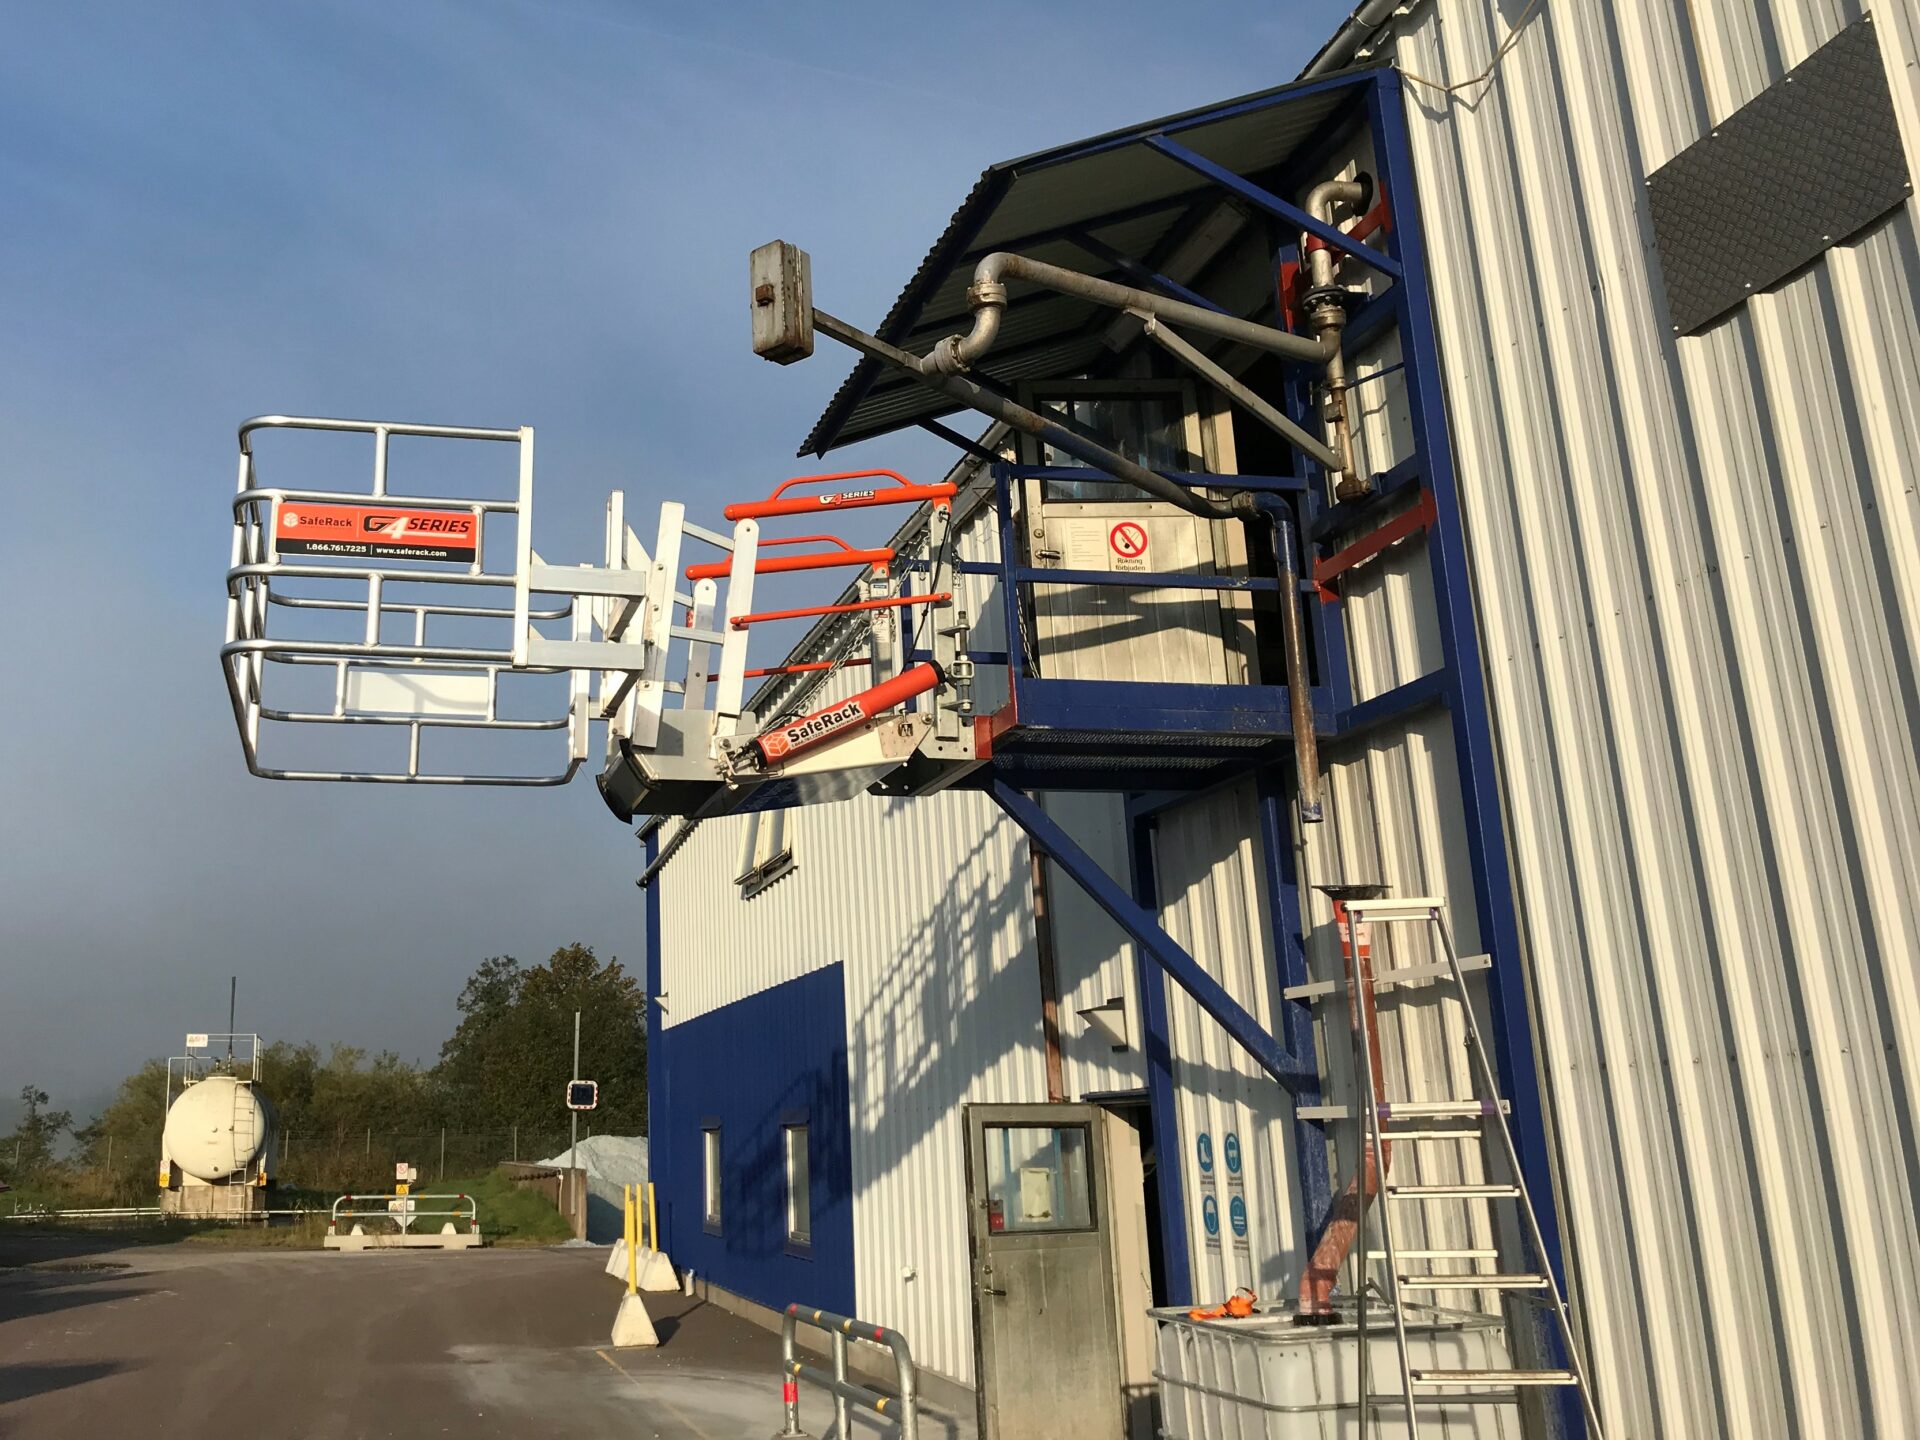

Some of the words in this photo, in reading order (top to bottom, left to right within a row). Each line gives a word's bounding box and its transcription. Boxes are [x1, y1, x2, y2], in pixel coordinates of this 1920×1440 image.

[842, 490, 875, 499] SERIES
[300, 516, 352, 528] SafeRack
[407, 517, 471, 533] SERIES
[306, 543, 367, 553] 1.866.761.7225
[376, 547, 447, 557] www.saferack.com
[787, 703, 861, 743] SafeRack
